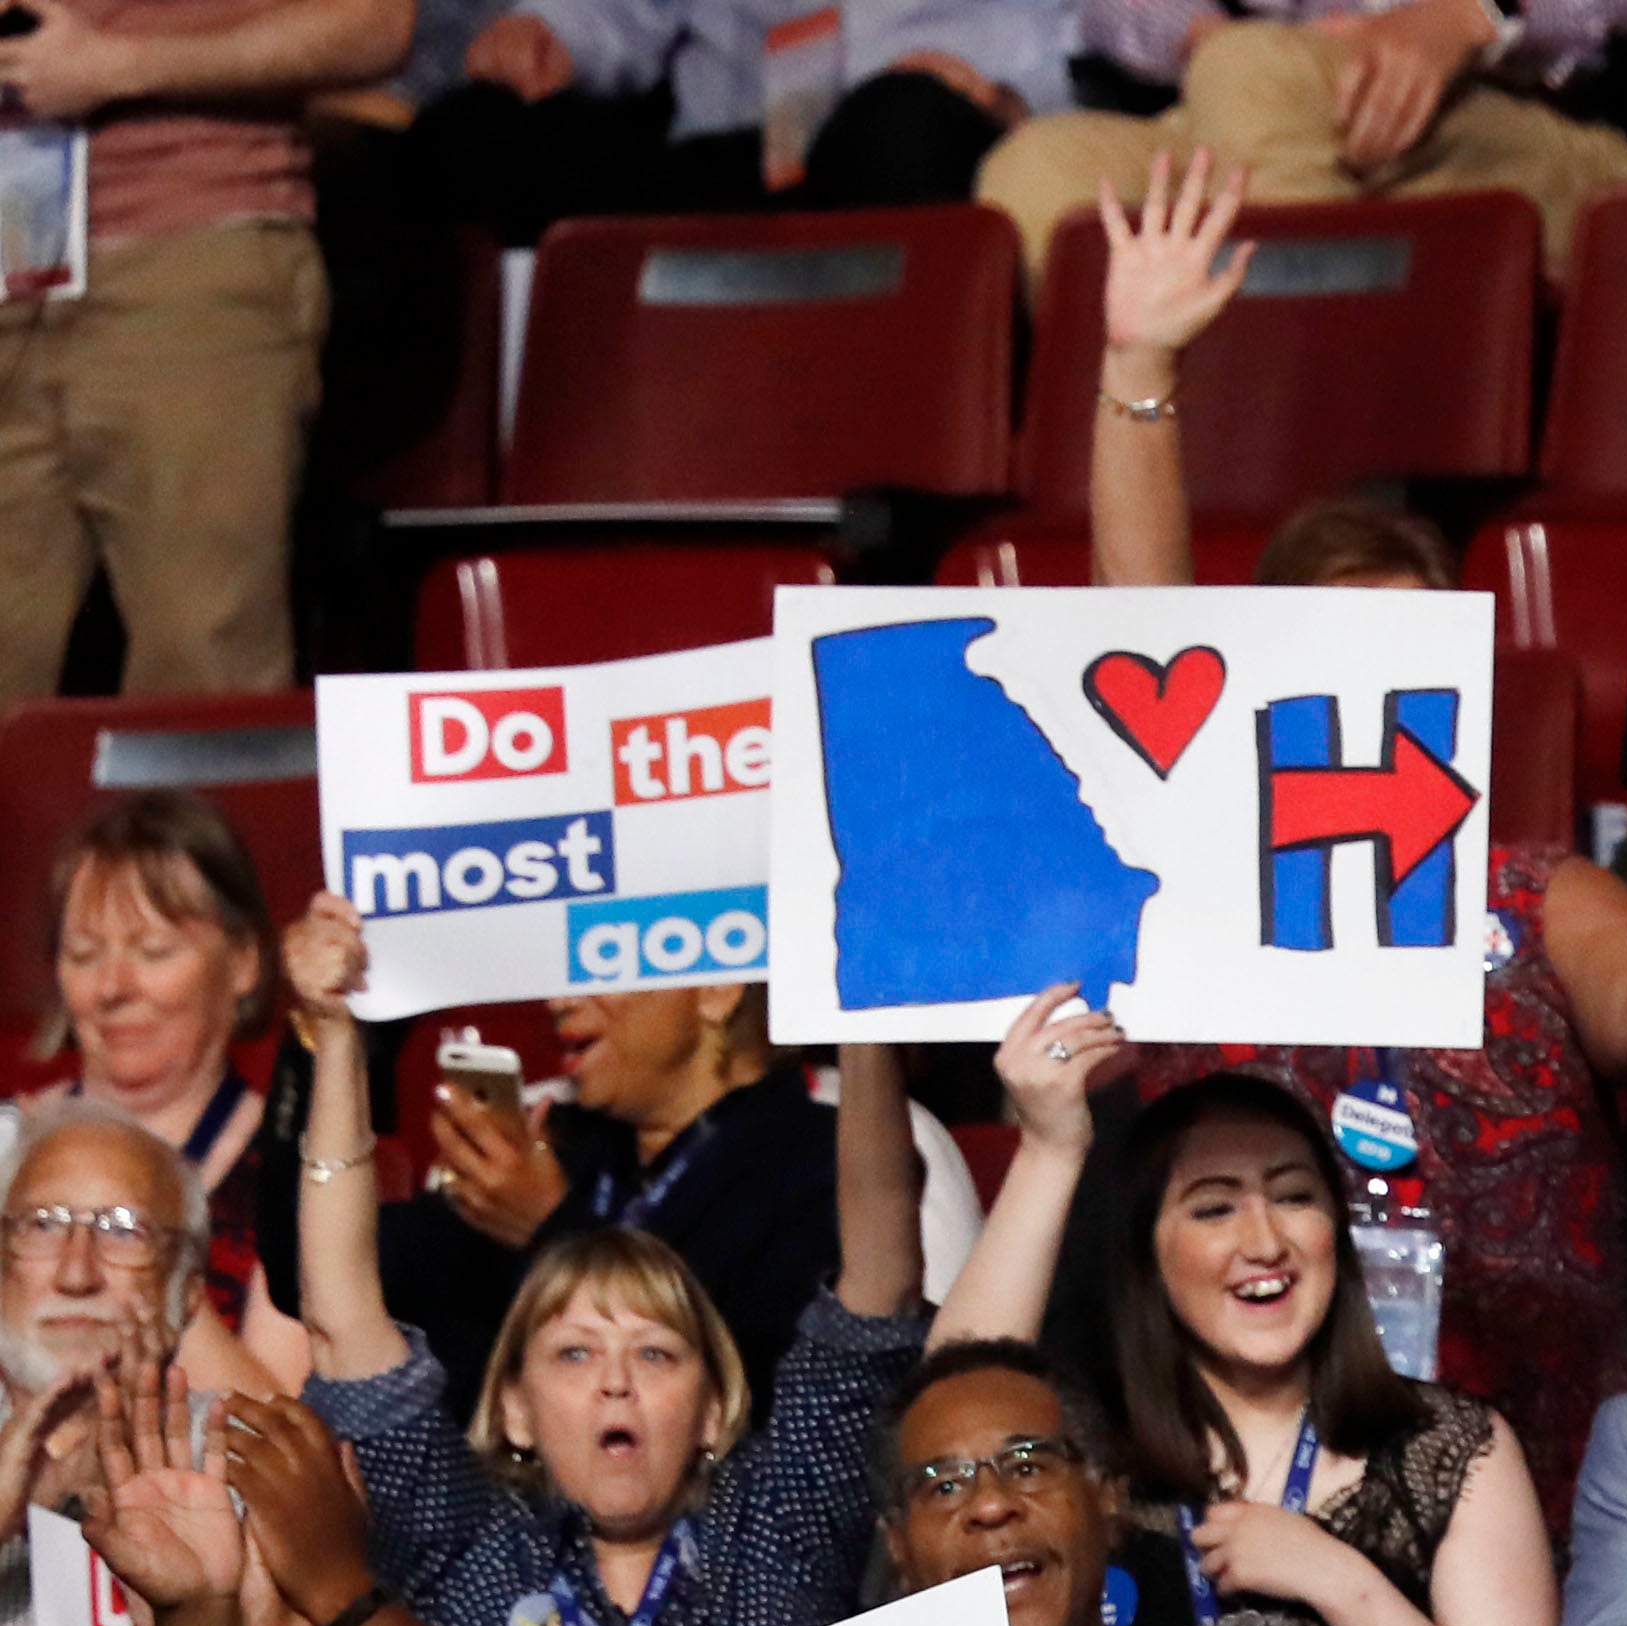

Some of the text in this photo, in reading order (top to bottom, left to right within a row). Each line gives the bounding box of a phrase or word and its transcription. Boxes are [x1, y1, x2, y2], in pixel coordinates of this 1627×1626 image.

[420, 697, 772, 799] Do the
[352, 819, 606, 911] most
